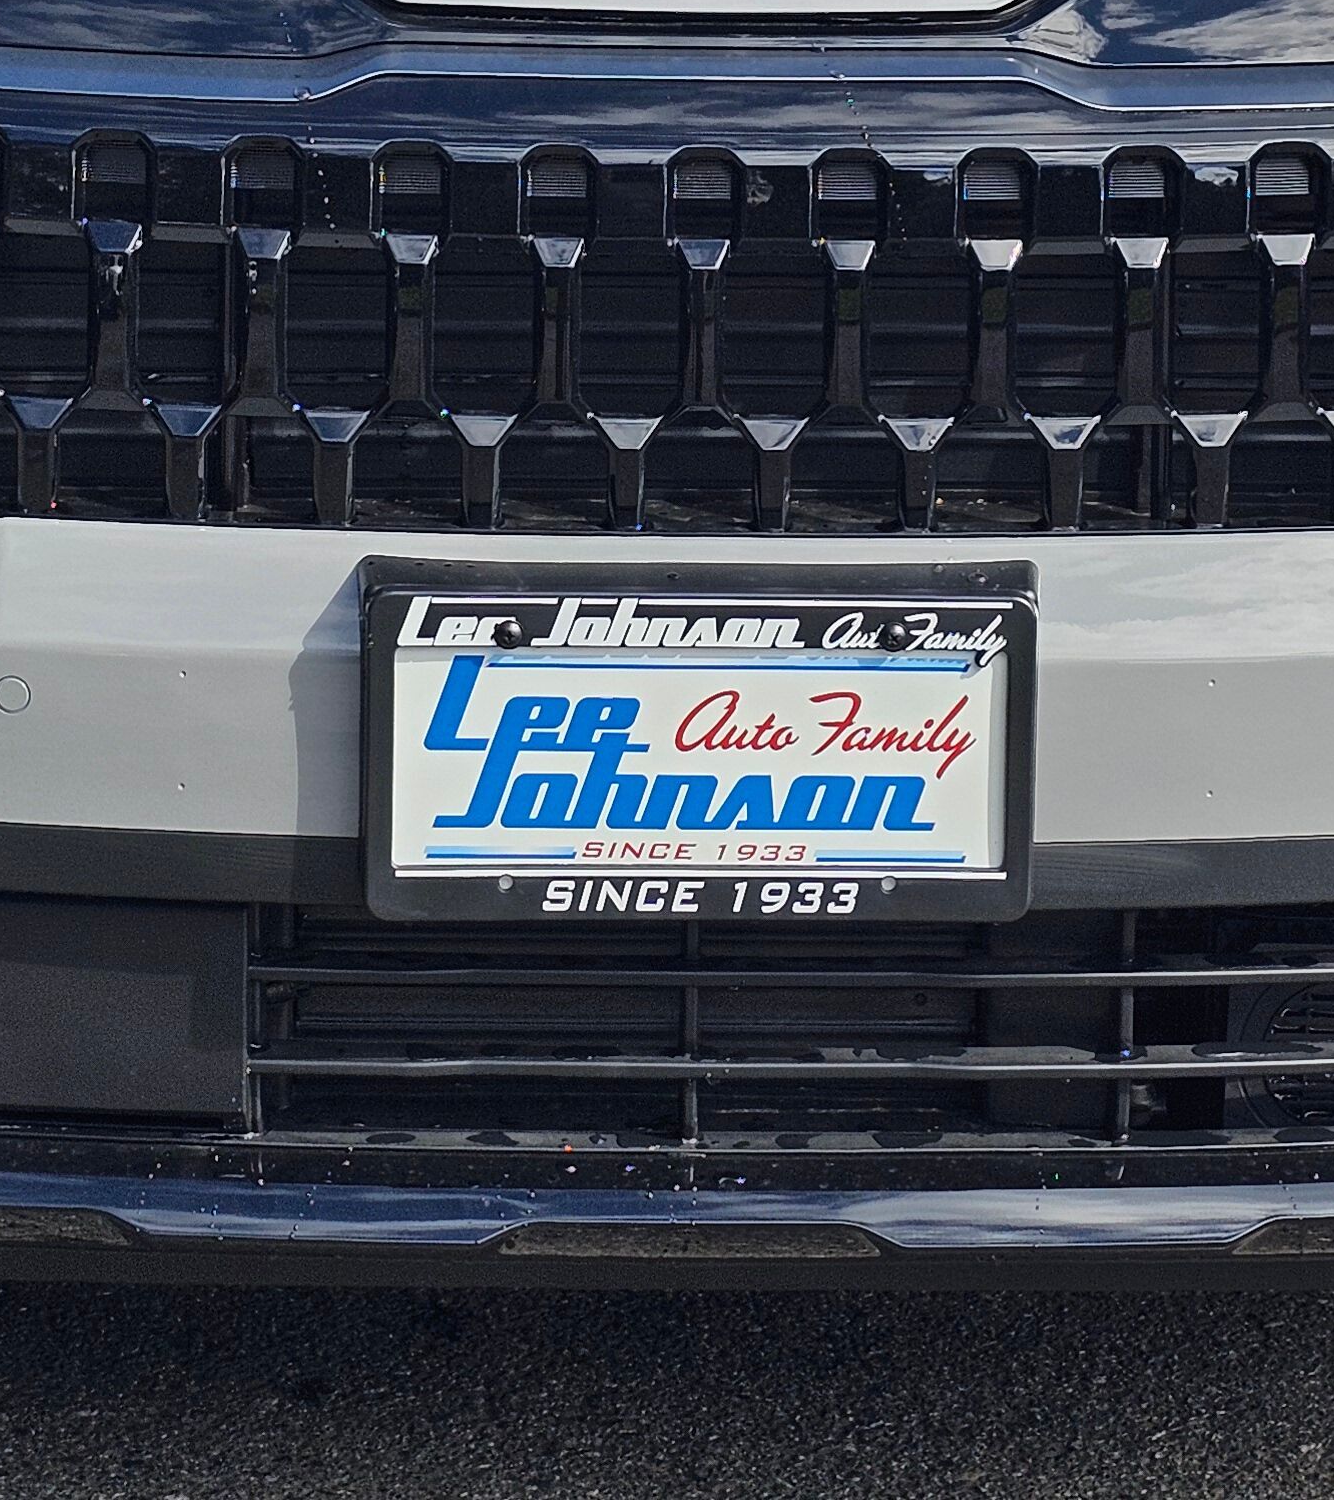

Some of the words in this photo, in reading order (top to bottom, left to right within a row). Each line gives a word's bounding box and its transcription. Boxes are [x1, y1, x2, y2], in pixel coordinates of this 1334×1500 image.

[530, 597, 805, 648] Johnson
[904, 612, 1008, 667] Family
[424, 655, 650, 752] Lee
[675, 690, 800, 752] Auto
[809, 691, 977, 780] Family
[433, 745, 936, 831] Johnson
[581, 841, 698, 861] SINCE
[717, 843, 808, 862] 1933
[541, 879, 706, 913] SINCE
[731, 881, 861, 914] 1933
